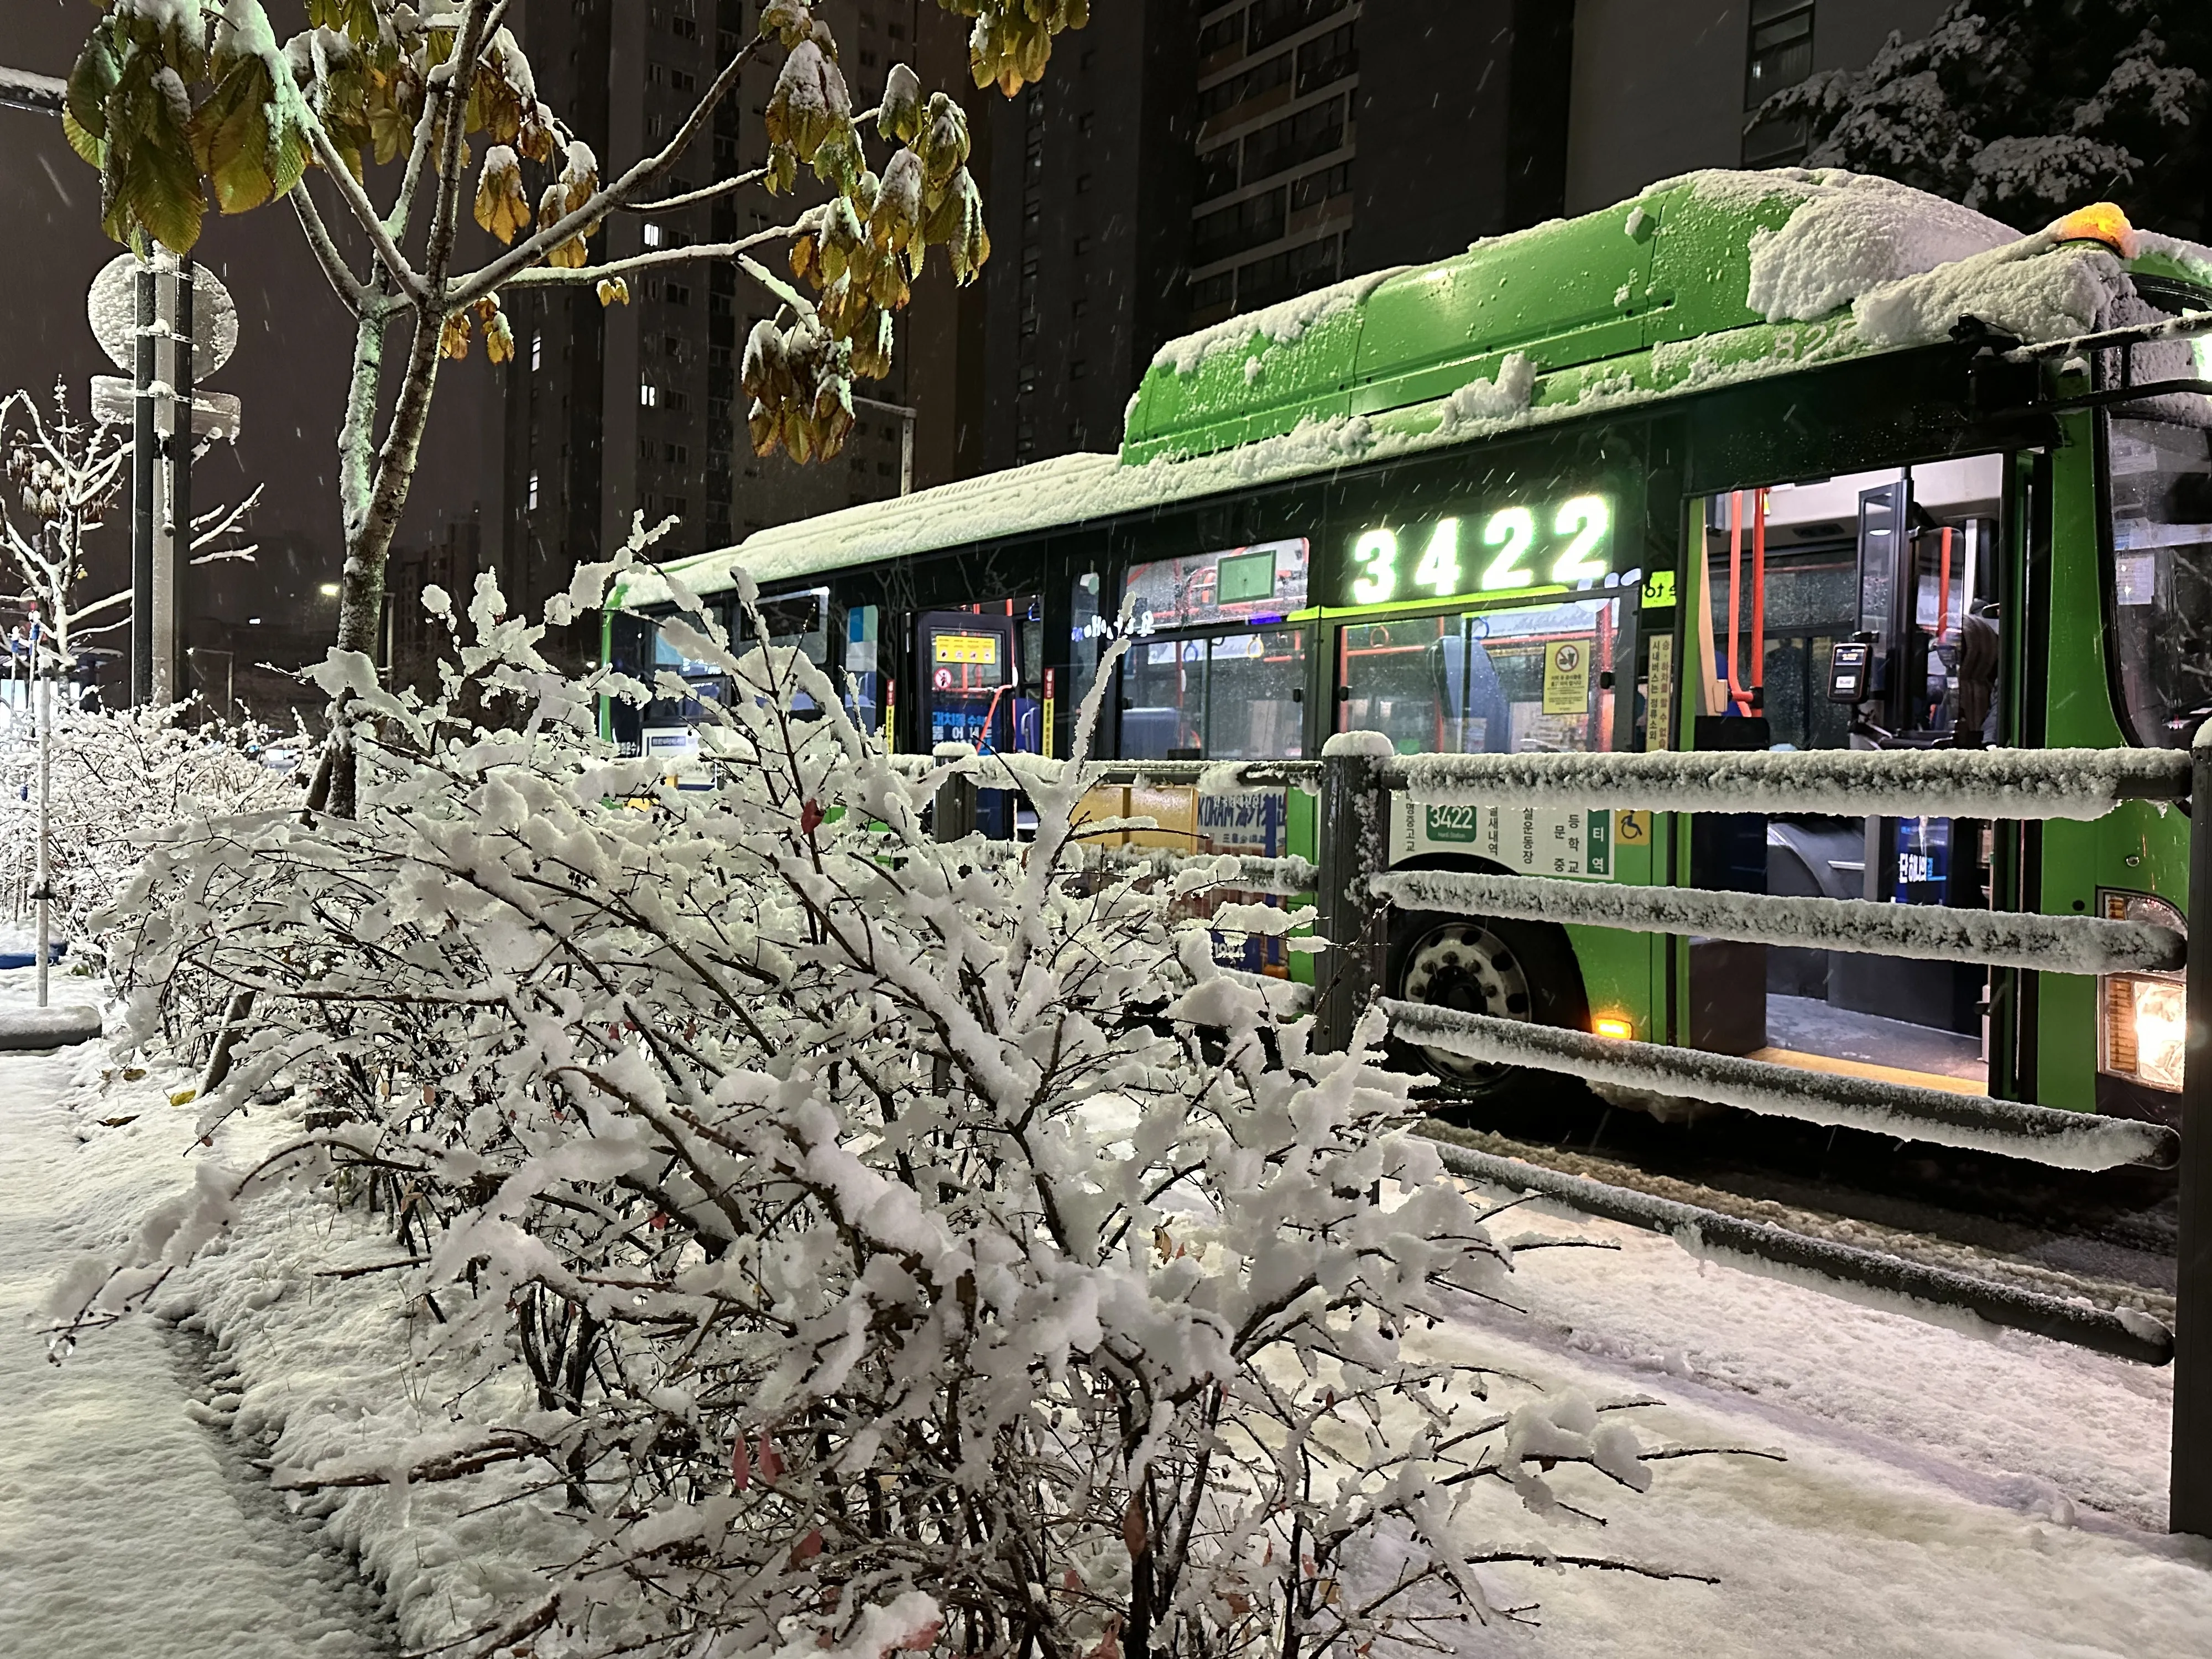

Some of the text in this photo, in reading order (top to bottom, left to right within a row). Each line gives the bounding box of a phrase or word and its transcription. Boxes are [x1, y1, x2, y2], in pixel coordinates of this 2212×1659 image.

[1354, 494, 1606, 604] 3422
[1649, 641, 1660, 740] 시내버스는 정류소외
[1658, 727, 1667, 748] 없습
[1430, 806, 1473, 829] 3422
[1488, 807, 1498, 856] 실새내역
[1523, 807, 1533, 864] 실운동장
[1568, 814, 1580, 873] 등학교
